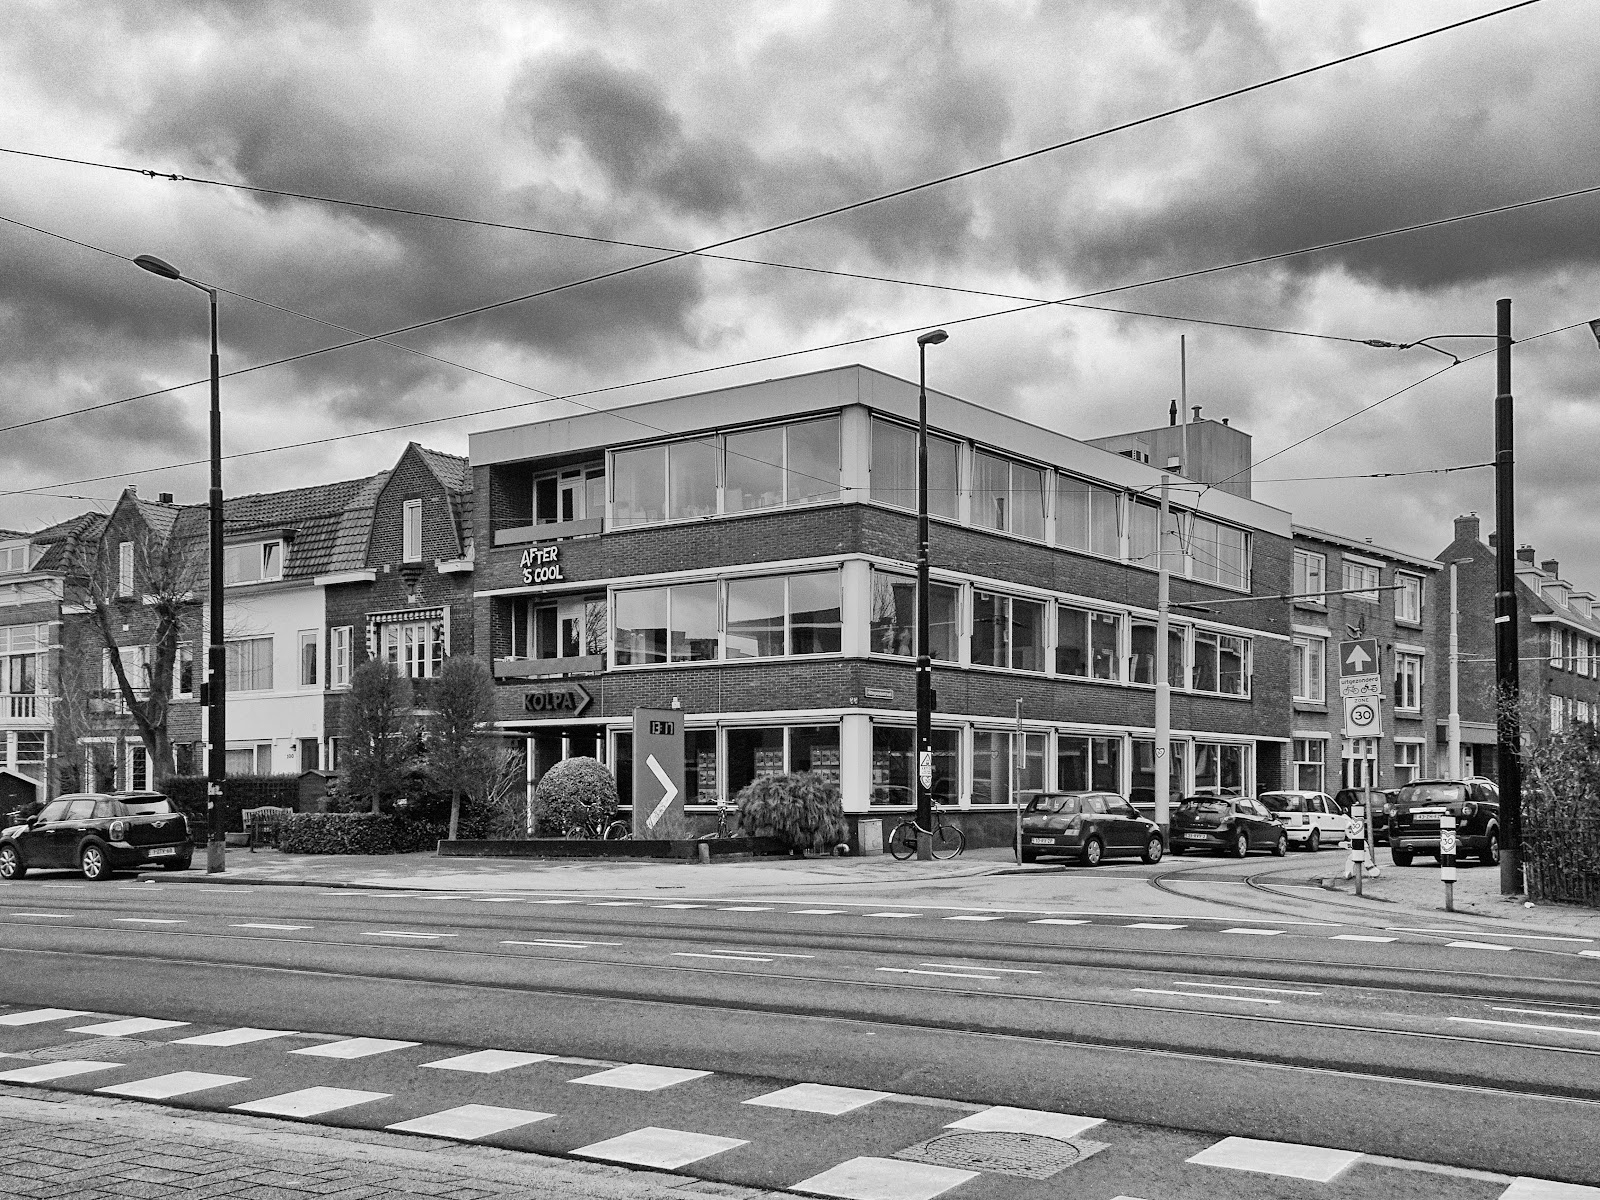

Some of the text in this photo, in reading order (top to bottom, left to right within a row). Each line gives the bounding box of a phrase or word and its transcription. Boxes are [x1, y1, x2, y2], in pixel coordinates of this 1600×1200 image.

[520, 546, 558, 567] AFTER
[534, 565, 564, 583] COOL
[523, 692, 574, 711] KOLPA
[1354, 710, 1371, 720] 30
